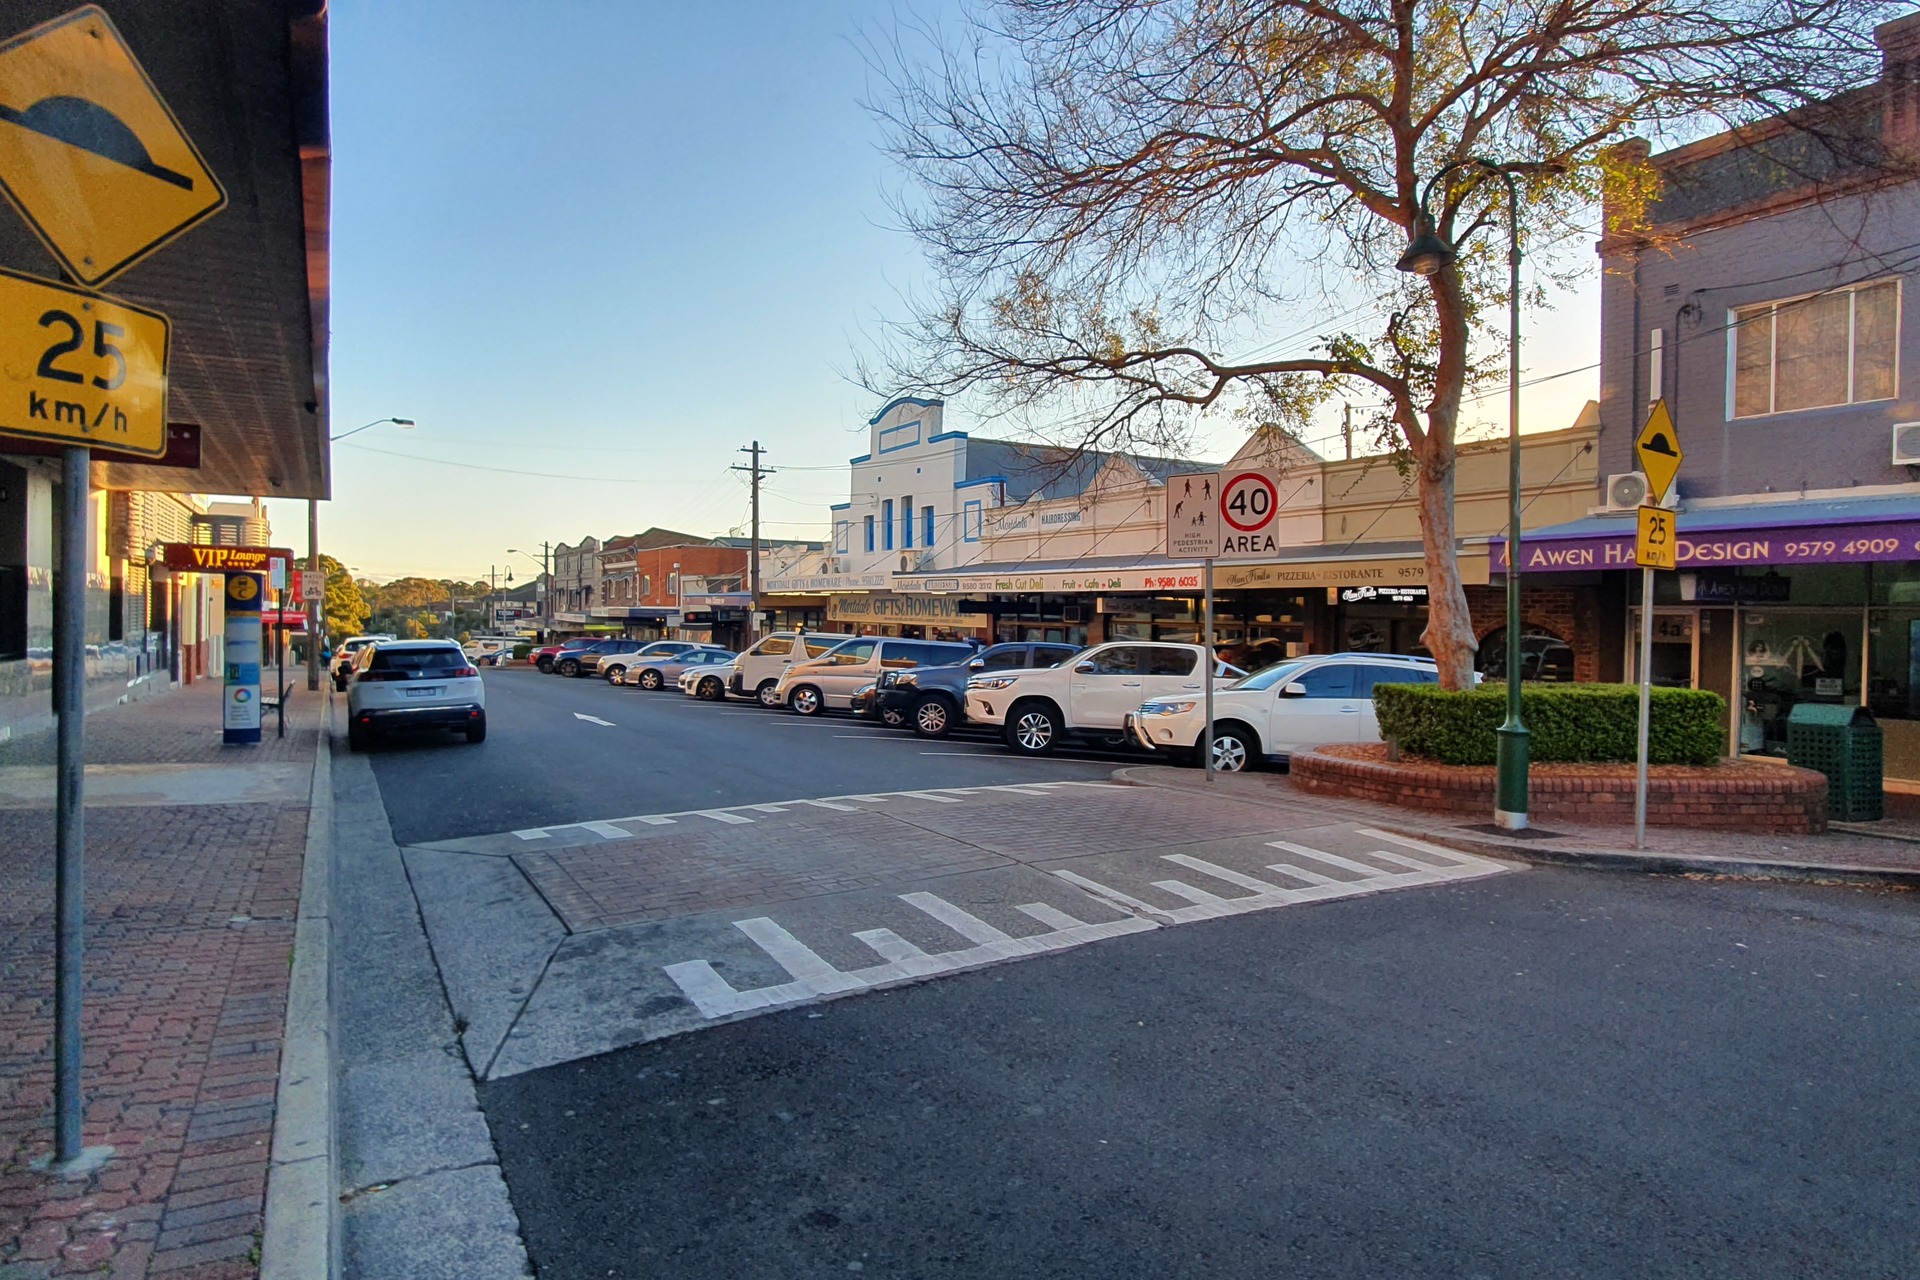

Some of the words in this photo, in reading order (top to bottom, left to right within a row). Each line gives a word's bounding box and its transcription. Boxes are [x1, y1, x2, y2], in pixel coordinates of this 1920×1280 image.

[36, 309, 127, 391] 25
[29, 391, 128, 433] km/h
[1228, 488, 1269, 516] 40
[1041, 511, 1081, 525] HAIRDRESSING
[1648, 516, 1667, 545] 25
[1223, 534, 1277, 553] AREA
[1604, 543, 1636, 564] HA
[1675, 540, 1769, 562] DESIGN
[1785, 542, 1836, 557] 9579
[1842, 538, 1900, 555] 4909
[192, 547, 228, 568] VIP
[229, 549, 267, 564] Lounge
[1646, 549, 1667, 561] km/h
[791, 579, 806, 589] GIFTS
[810, 577, 841, 588] HOMEWARE
[995, 578, 1013, 590] Fresh
[1015, 578, 1028, 590] Cut
[1029, 577, 1044, 590] Deli
[1062, 579, 1076, 589] Fruit
[1108, 577, 1121, 589] Deli
[1158, 576, 1176, 588] 9580
[1178, 575, 1198, 587] 6035
[1277, 571, 1316, 581] PIZZERIA
[1323, 569, 1384, 580] RISTORANTE
[1398, 567, 1424, 578] 9579
[838, 598, 871, 615] Mortdale
[873, 598, 902, 616] GIFTS
